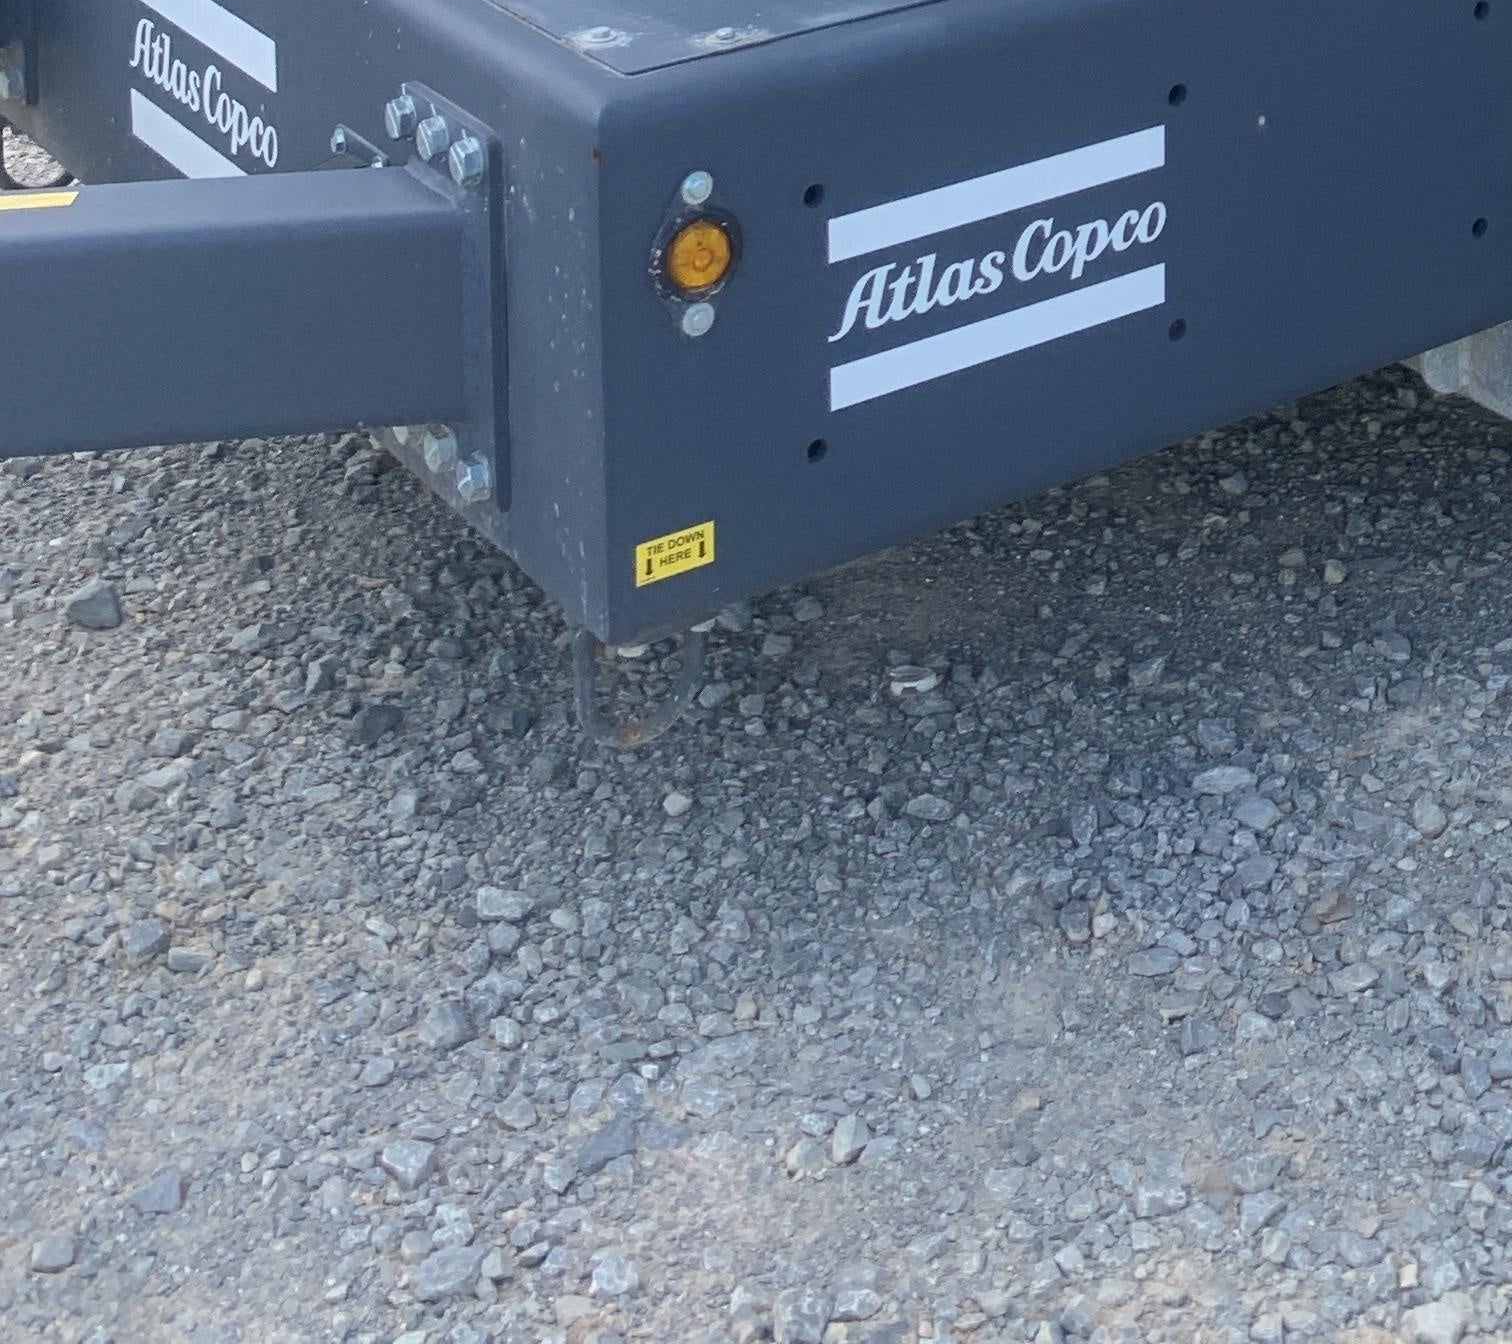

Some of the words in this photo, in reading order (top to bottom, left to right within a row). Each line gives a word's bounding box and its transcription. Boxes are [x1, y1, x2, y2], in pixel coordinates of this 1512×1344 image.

[130, 18, 202, 114] Atlas
[203, 64, 279, 168] Copco
[827, 248, 1006, 343] Atlas
[1011, 200, 1168, 283] Copco
[647, 543, 665, 557] TIE
[667, 530, 704, 549] DOWN
[659, 548, 692, 567] HERE
